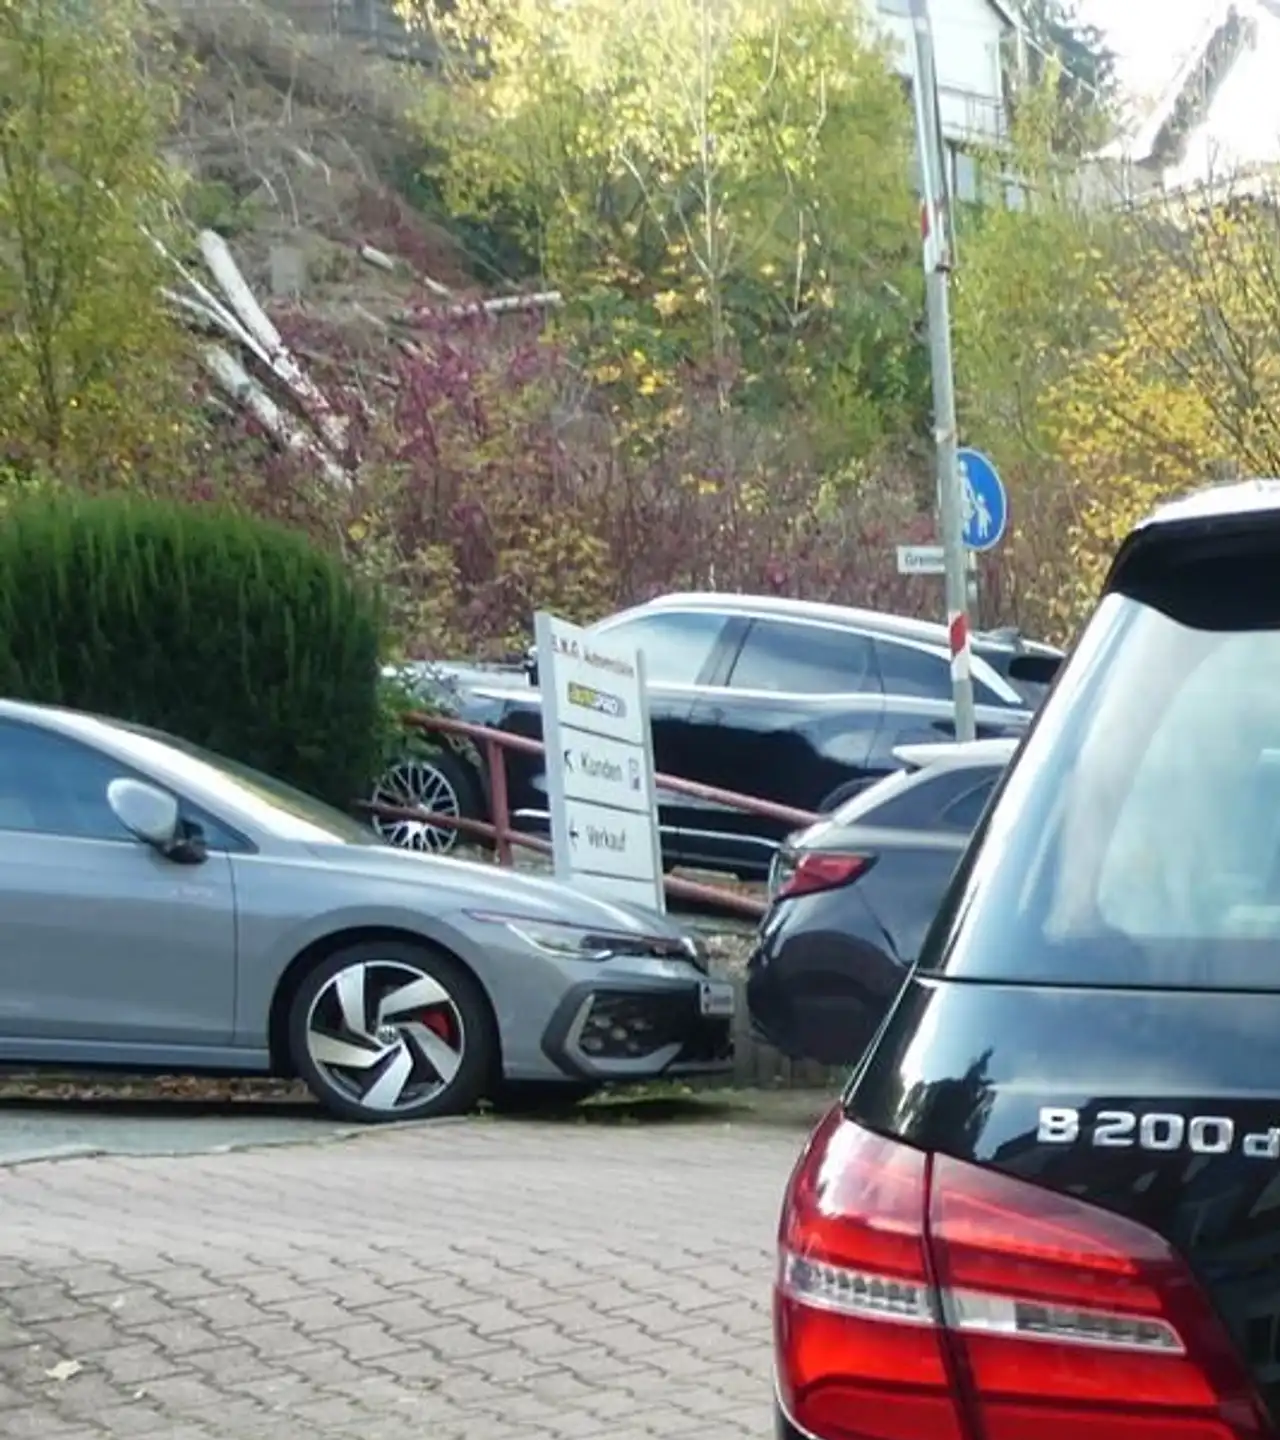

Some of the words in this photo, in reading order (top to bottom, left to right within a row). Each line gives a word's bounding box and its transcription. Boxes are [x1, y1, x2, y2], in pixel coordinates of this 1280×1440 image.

[585, 824, 627, 854] Verkauf
[1037, 1106, 1080, 1143] B
[1092, 1110, 1235, 1154] 200
